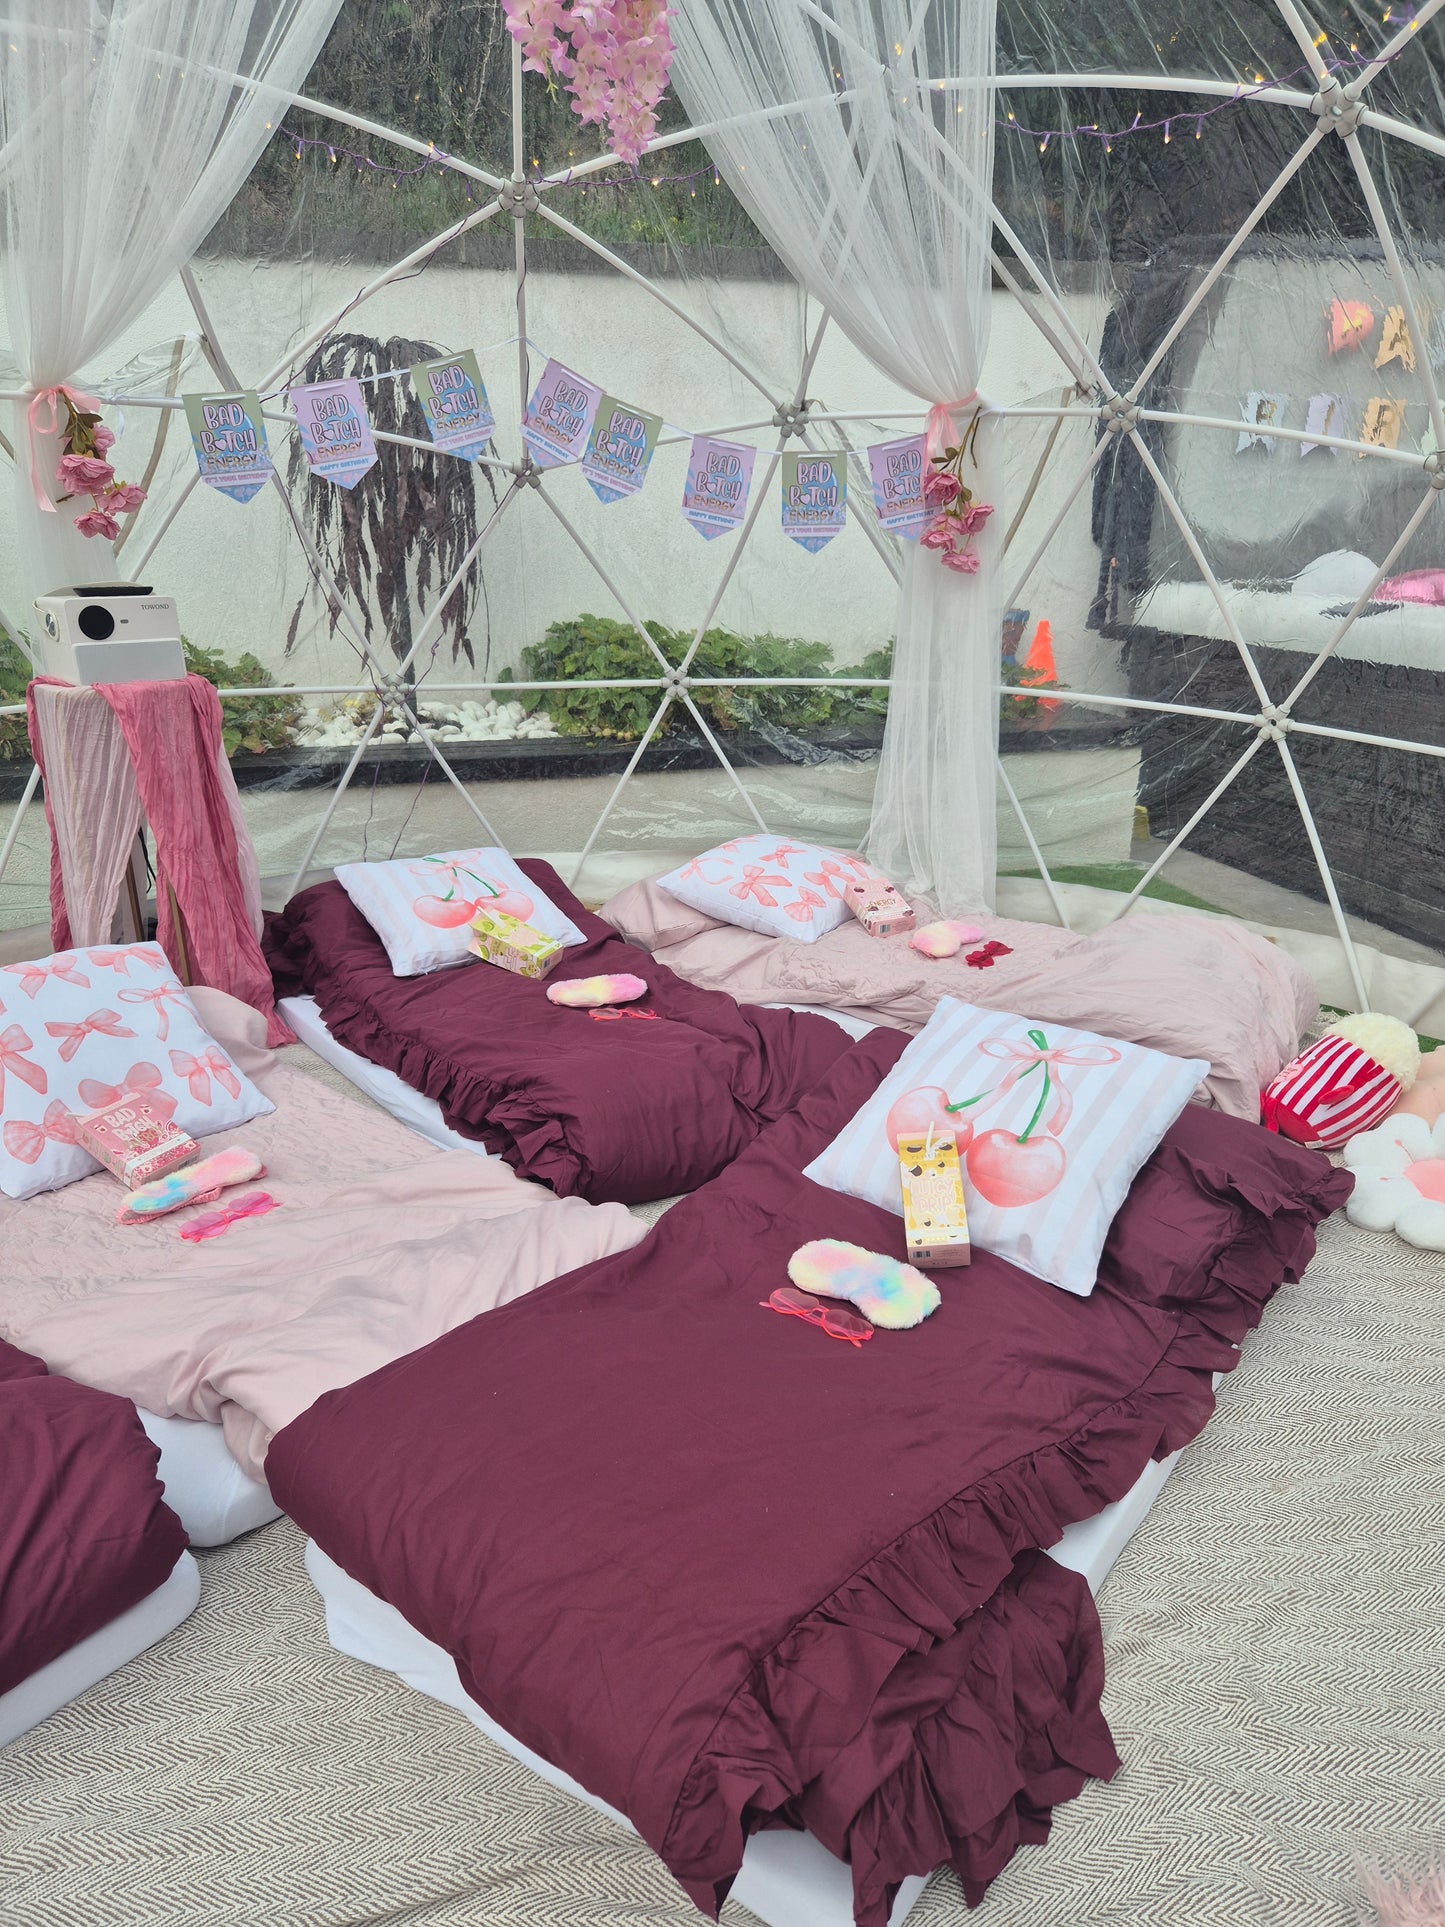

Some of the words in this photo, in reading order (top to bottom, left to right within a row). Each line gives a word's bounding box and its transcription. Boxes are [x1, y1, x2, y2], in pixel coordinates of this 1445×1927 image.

[428, 365, 465, 395] BAD
[312, 394, 349, 421] BAD
[554, 380, 588, 412] BAD
[202, 402, 244, 430] BAD
[437, 413, 480, 434] ENERGY
[609, 410, 645, 440] BAD
[534, 417, 574, 444] ENERGY
[317, 442, 361, 458] ENERGY
[526, 430, 544, 443] HAPPY
[543, 440, 569, 458] BIRTHDAY
[207, 454, 257, 469] ENERGY
[320, 463, 339, 471] HAPPY
[340, 458, 369, 468] BIRTHDAY
[592, 453, 635, 477] ENERGY
[706, 451, 740, 477] BAD
[797, 460, 833, 485] BAD
[886, 449, 921, 478] BAD
[694, 494, 735, 511] ENERGY
[689, 510, 708, 518] HAPPY
[708, 514, 735, 525] BIRTHDAY
[789, 509, 835, 521] ENERGY
[886, 516, 906, 525] HAPPY
[102, 1108, 136, 1128] BAD
